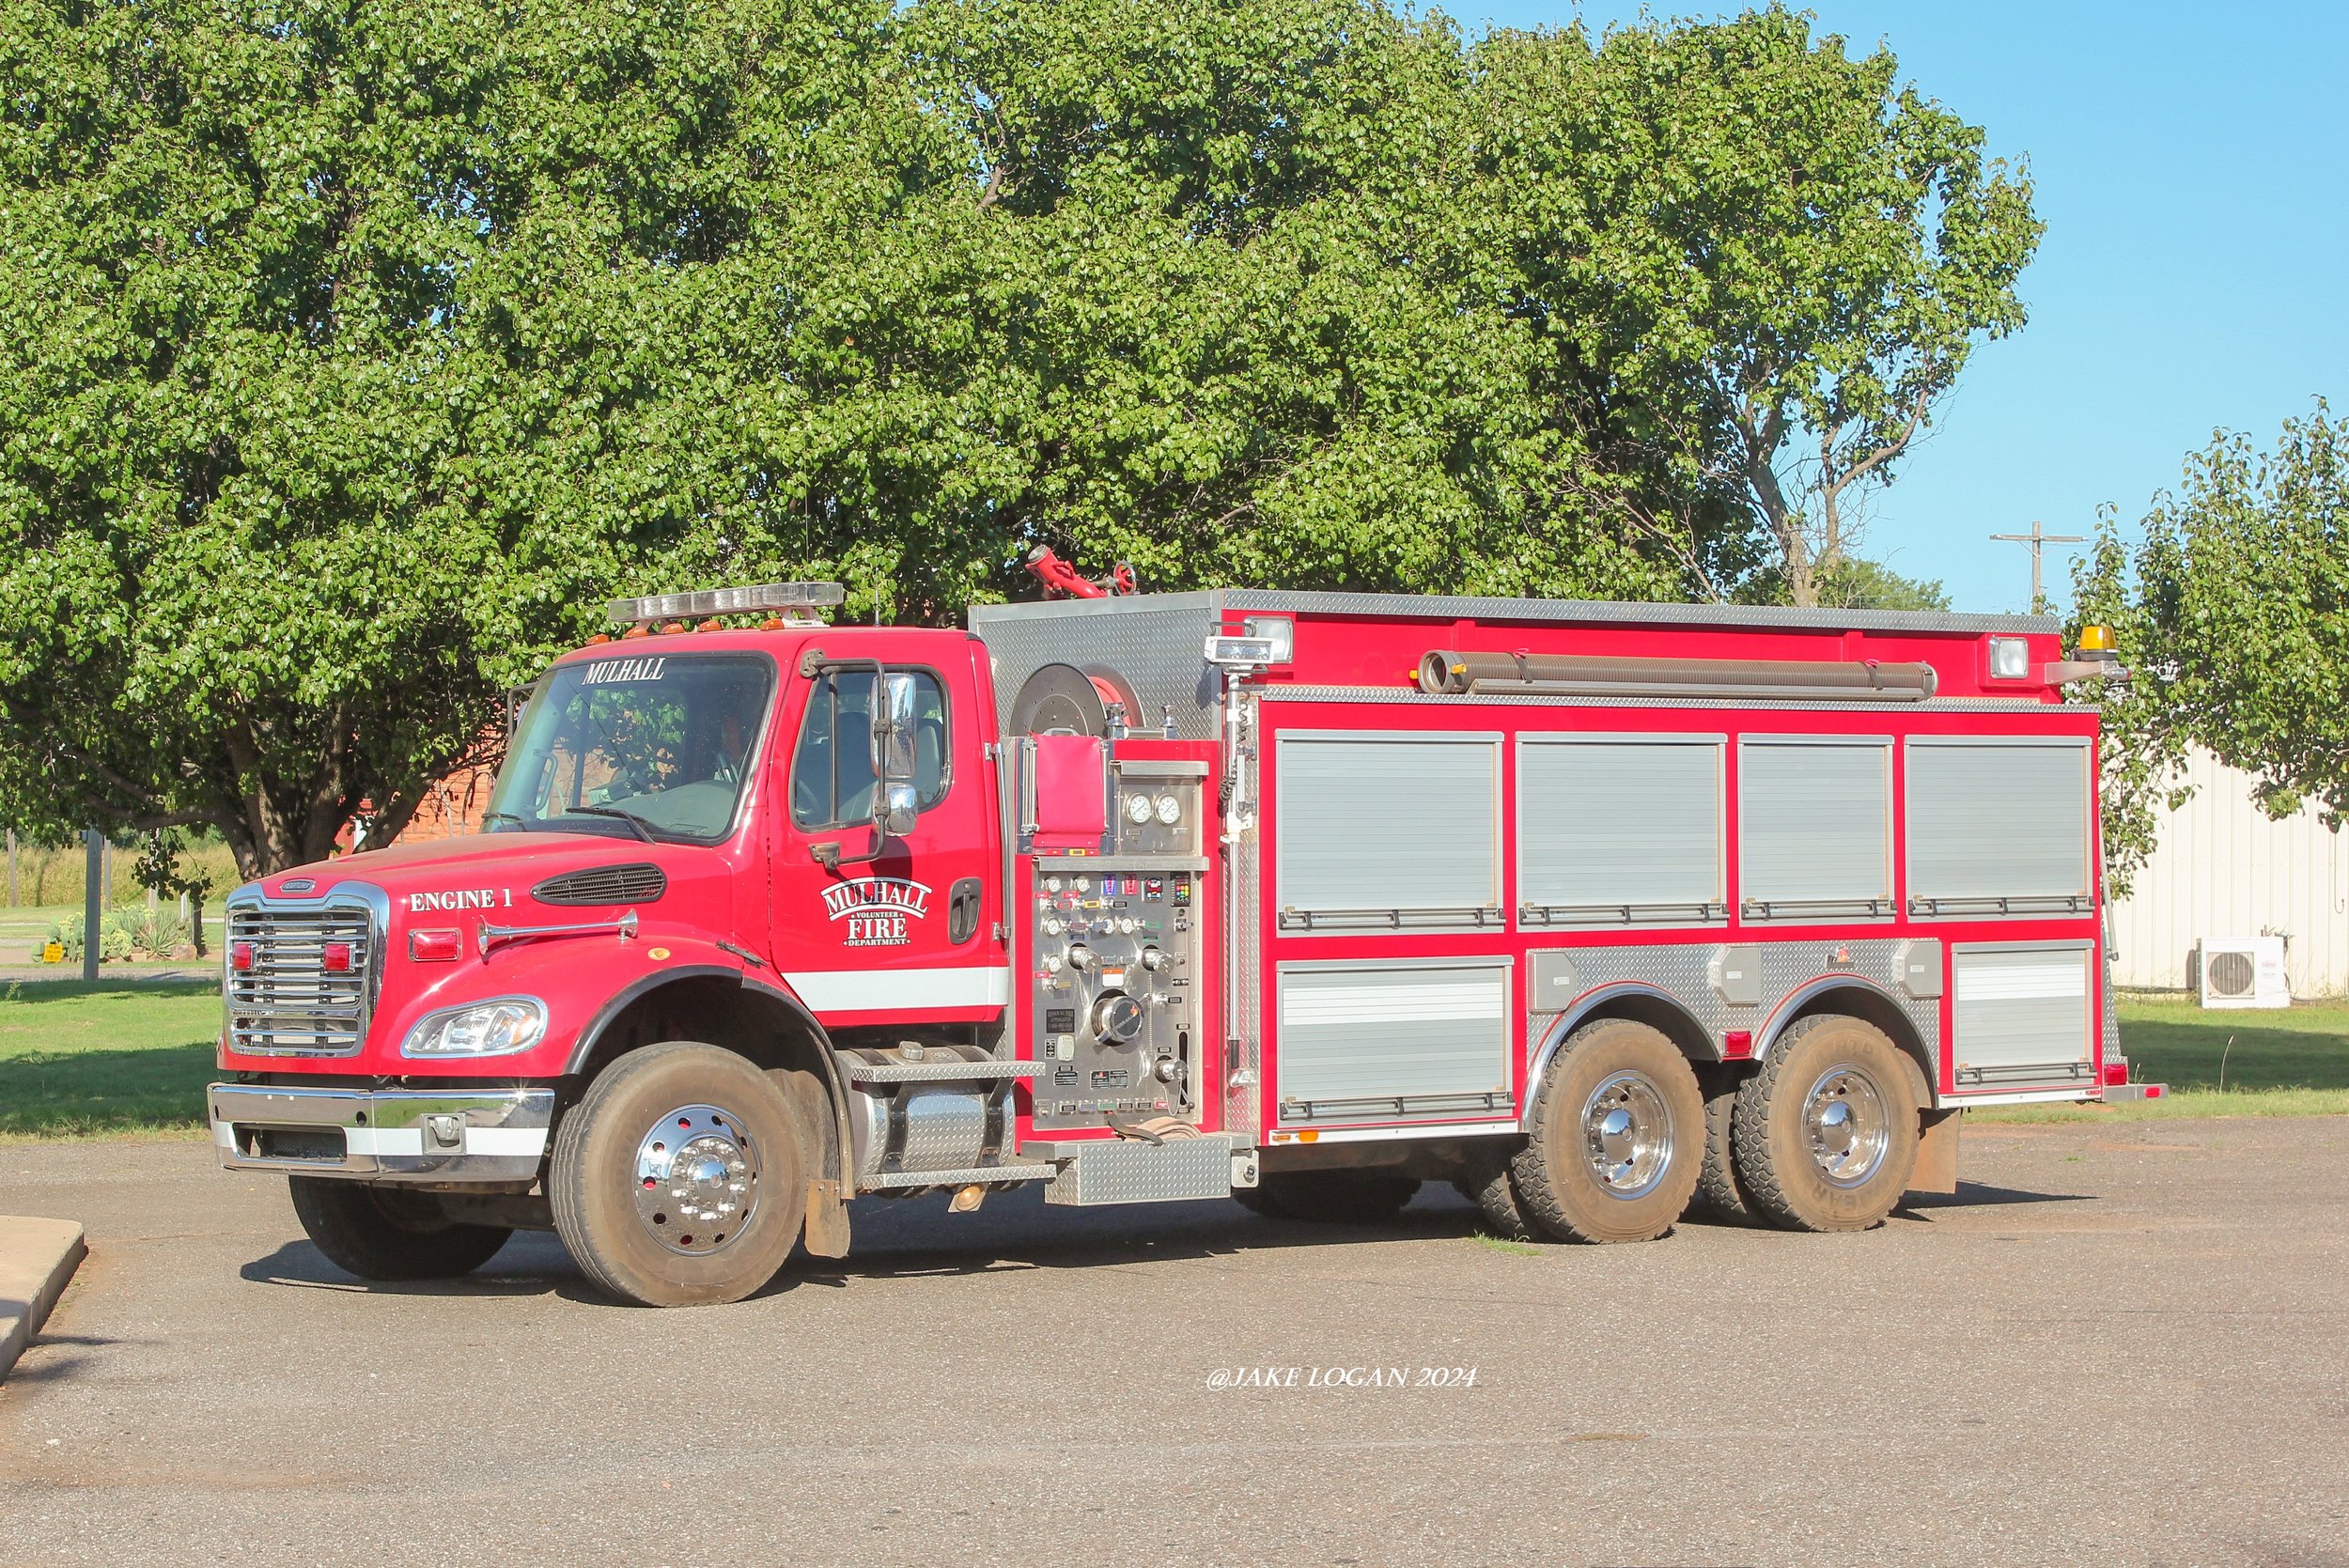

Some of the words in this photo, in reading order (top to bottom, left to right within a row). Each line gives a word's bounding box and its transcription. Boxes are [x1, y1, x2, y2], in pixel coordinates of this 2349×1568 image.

[582, 658, 666, 685] MULHALL
[410, 889, 495, 912] ENGINE
[502, 888, 513, 908] 1
[823, 879, 928, 916] MULHALL
[848, 918, 908, 939] FIRE
